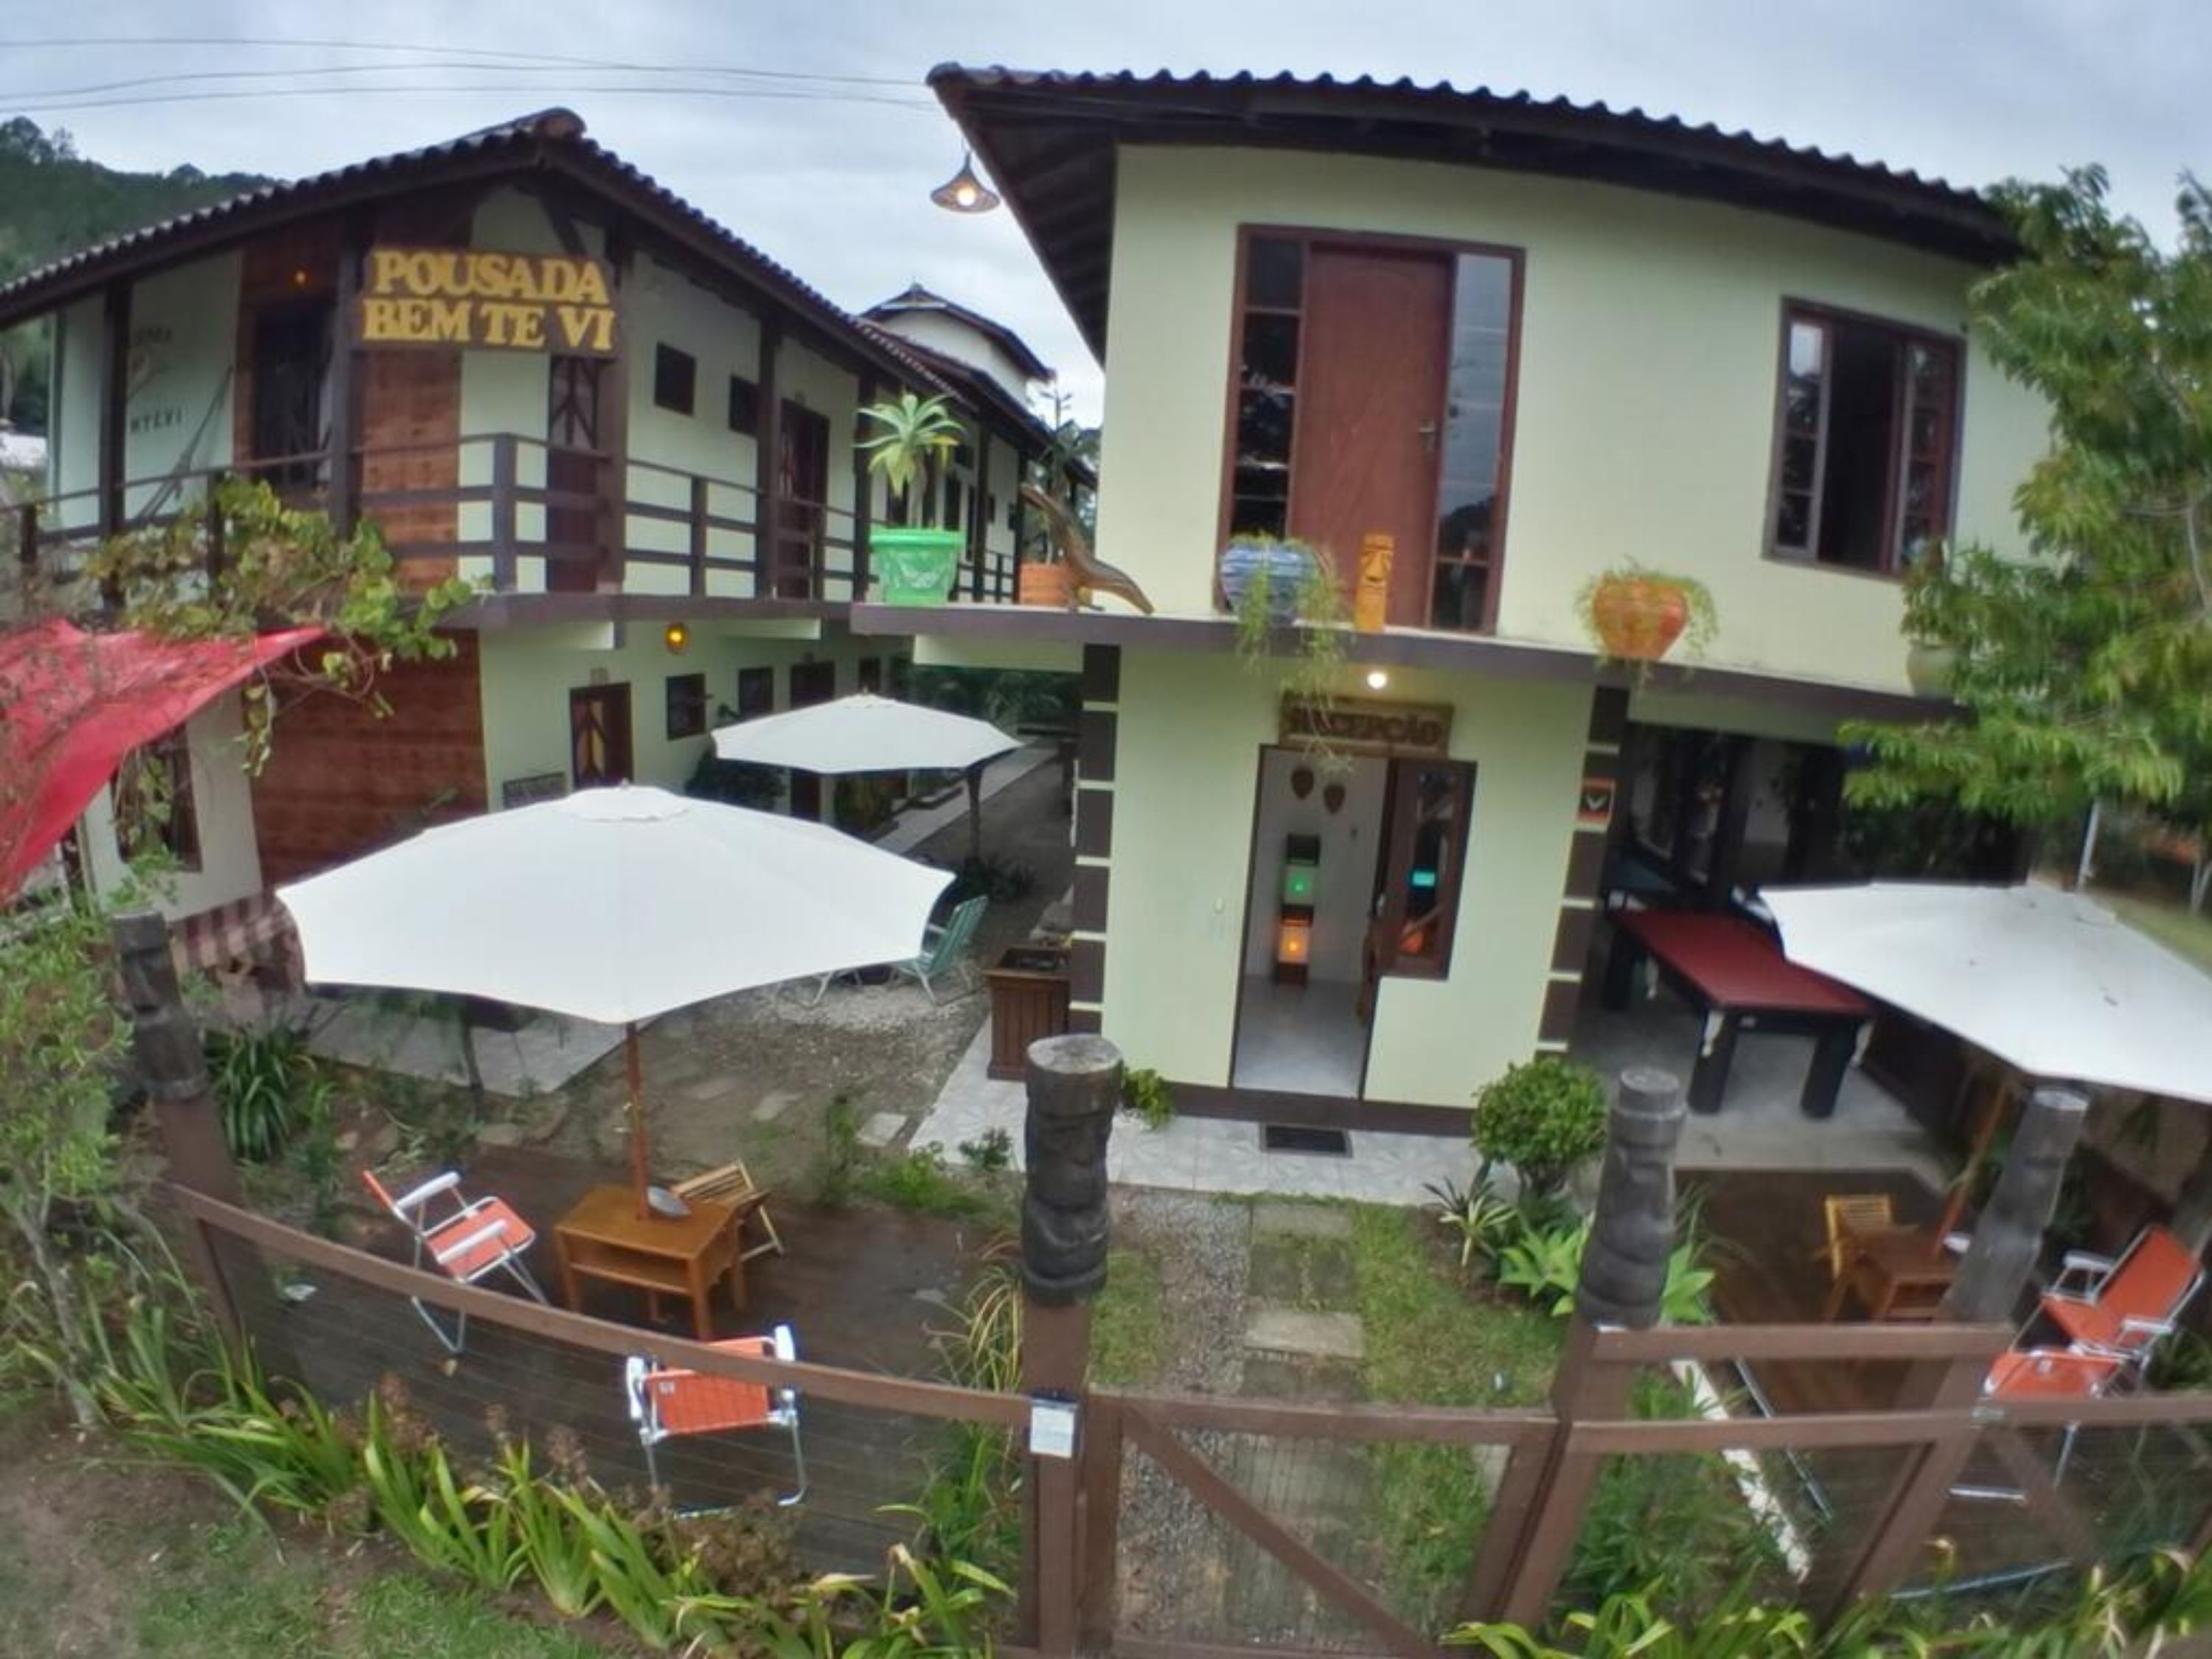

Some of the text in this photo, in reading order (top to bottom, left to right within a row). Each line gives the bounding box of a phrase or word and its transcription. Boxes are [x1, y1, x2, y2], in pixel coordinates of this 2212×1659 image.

[374, 251, 609, 304] POUSADA
[363, 299, 616, 351] BEM TE VI
